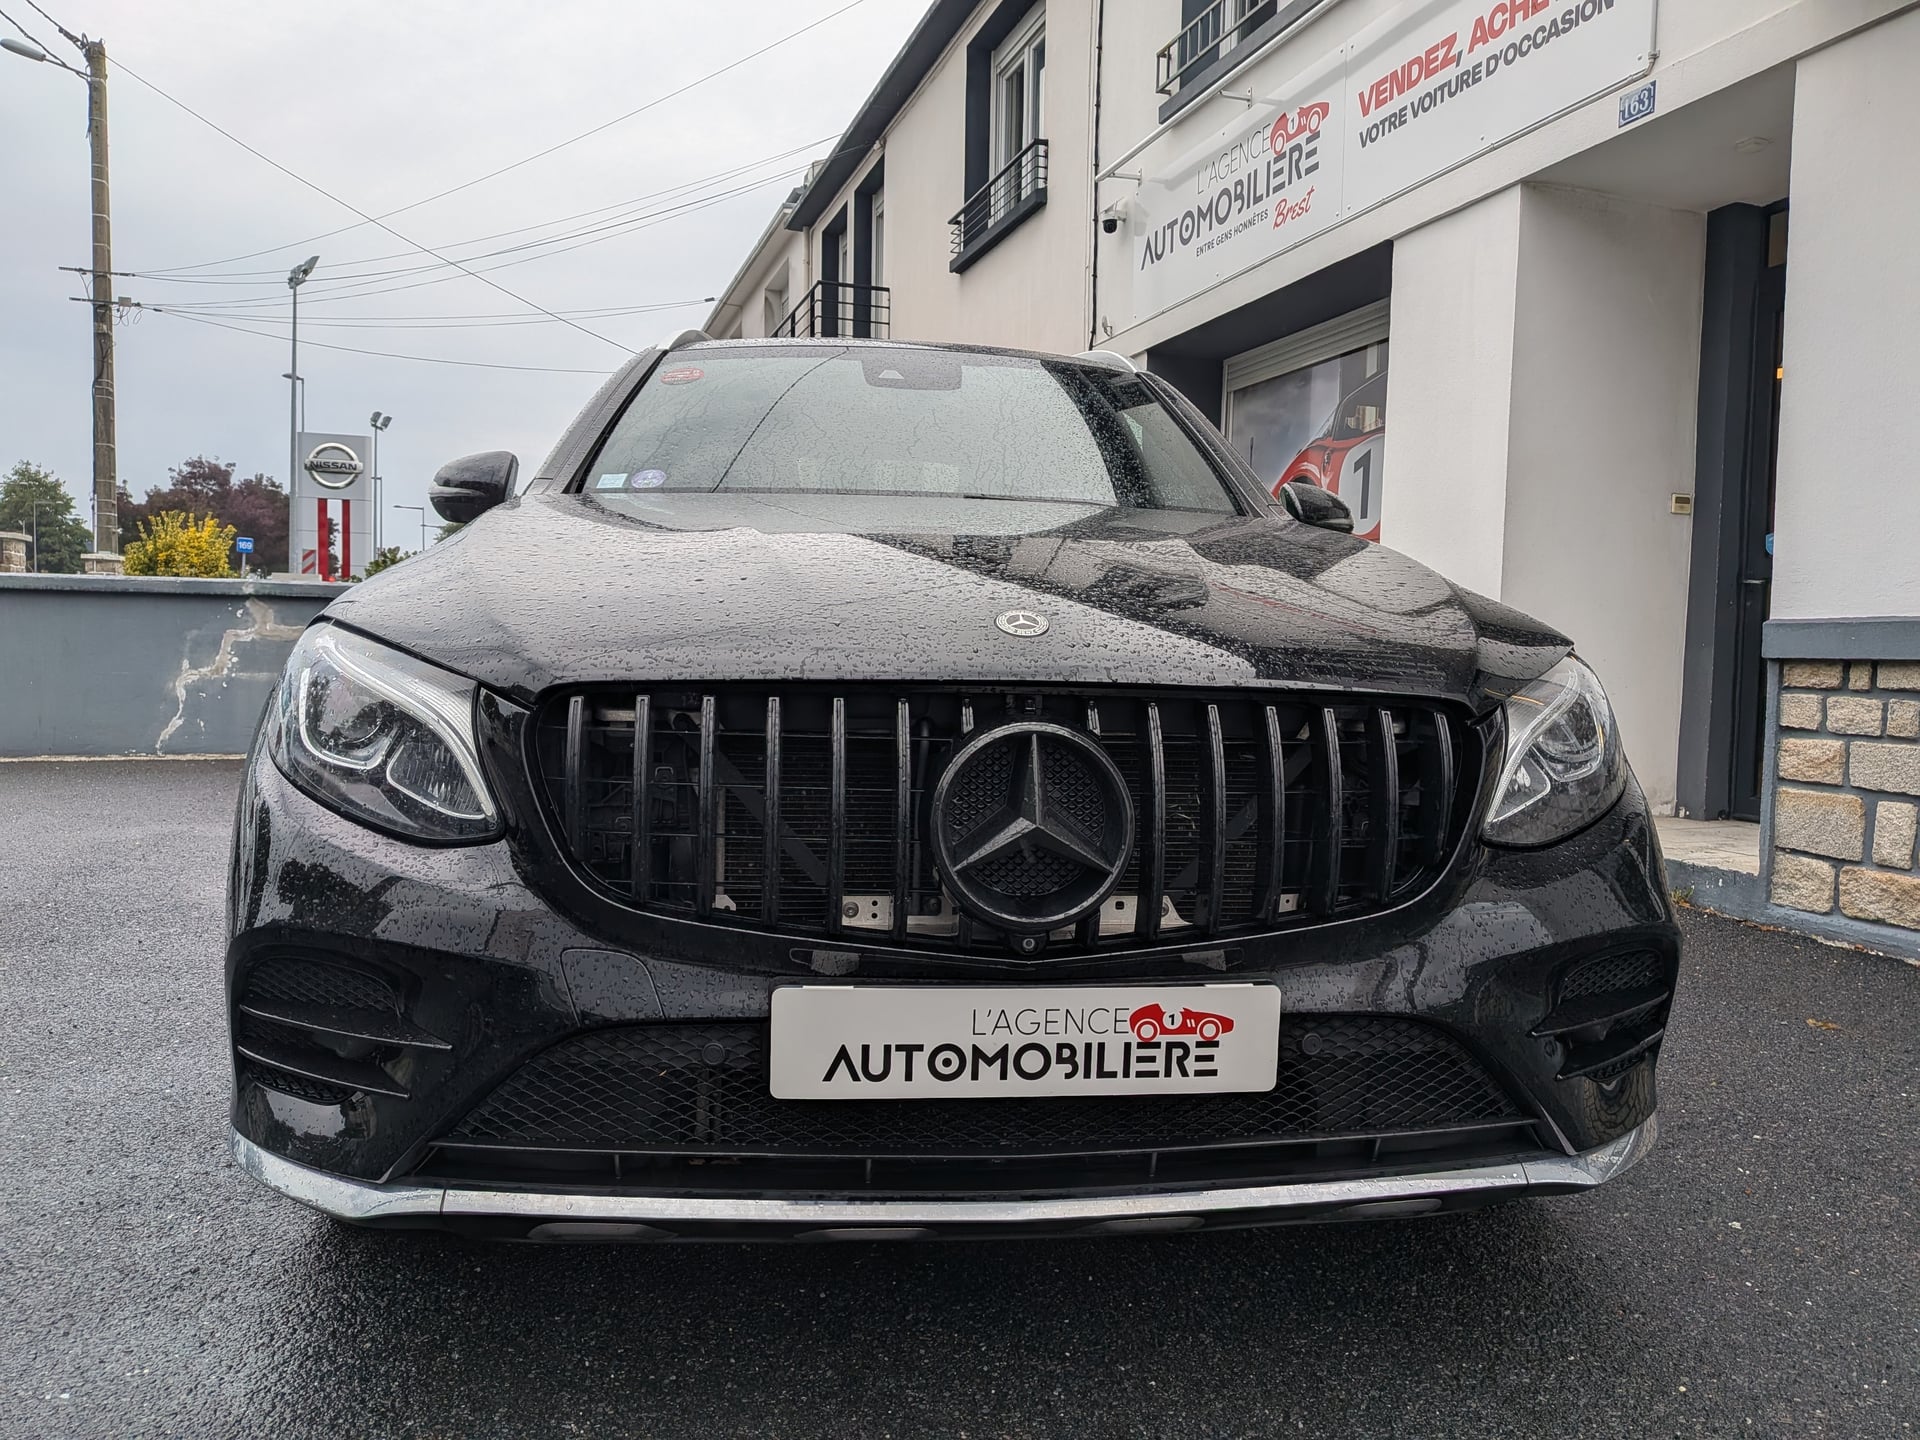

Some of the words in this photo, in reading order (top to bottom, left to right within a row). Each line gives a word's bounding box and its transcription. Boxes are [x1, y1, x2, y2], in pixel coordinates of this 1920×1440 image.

[1358, 32, 1463, 118] VENDEZ,
[1289, 117, 1296, 130] 1
[1359, 105, 1408, 149] VOTRE
[1410, 61, 1483, 120] VOITURE
[1622, 90, 1649, 119] 163
[1197, 123, 1272, 195] L'AGENCE
[1273, 185, 1316, 230] Brest
[1196, 239, 1215, 257] ENTRE
[1216, 229, 1233, 246] GENS
[1233, 209, 1269, 237] HONNÊTES
[310, 460, 358, 471] NISSAN
[1353, 448, 1372, 520] 1
[972, 1008, 1130, 1036] L'AGENCE
[1168, 1013, 1175, 1026] 1
